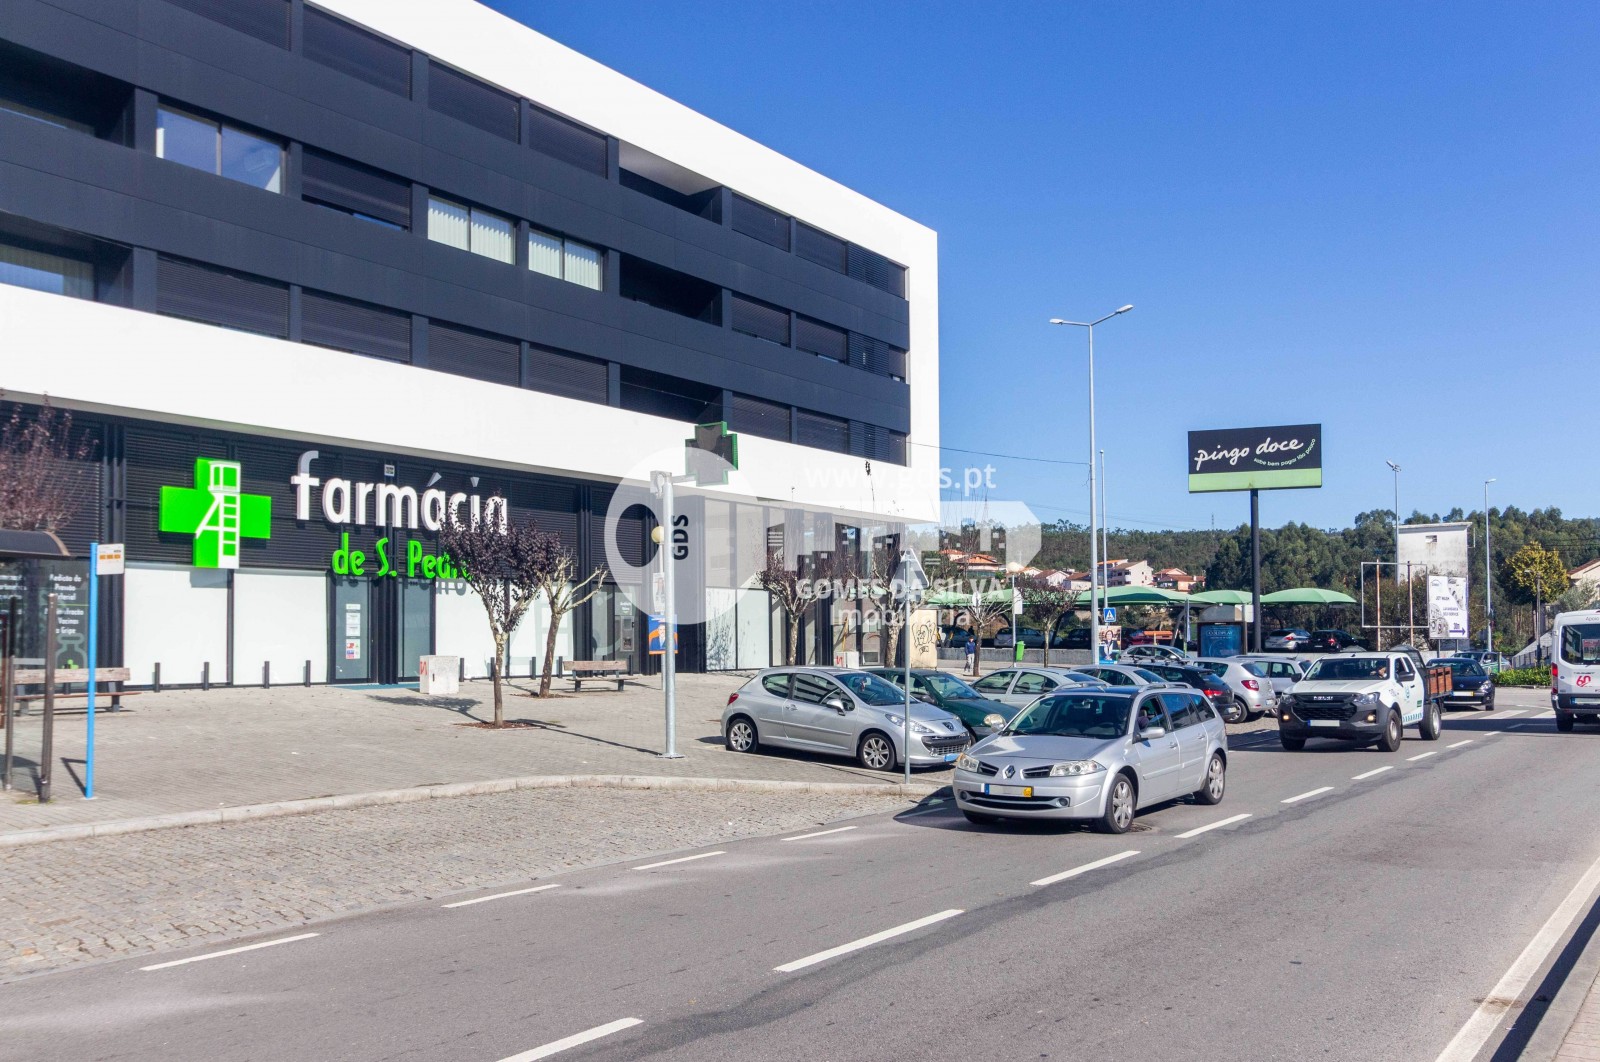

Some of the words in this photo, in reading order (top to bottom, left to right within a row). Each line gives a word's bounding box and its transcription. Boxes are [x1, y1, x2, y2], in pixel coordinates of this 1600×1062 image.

[1194, 445, 1250, 471] pingo
[1256, 437, 1304, 455] doce
[1280, 457, 1297, 467] pagar
[1305, 438, 1316, 455] pouco
[291, 450, 508, 536] farmácia
[332, 532, 365, 575] de
[375, 537, 398, 577] S.
[407, 540, 474, 581] Ped
